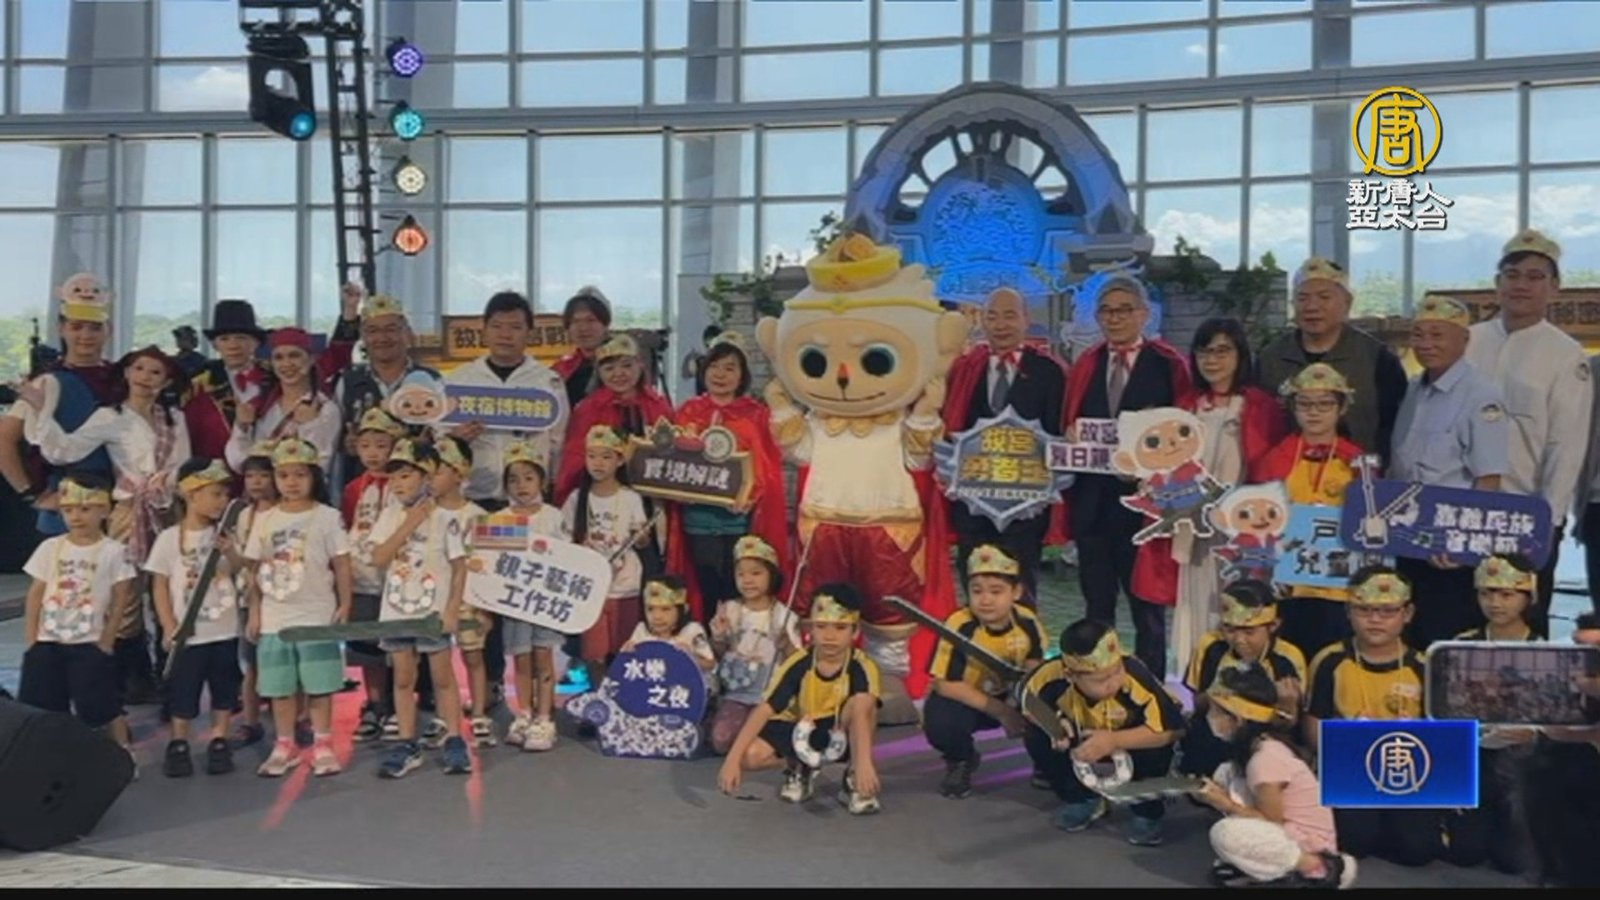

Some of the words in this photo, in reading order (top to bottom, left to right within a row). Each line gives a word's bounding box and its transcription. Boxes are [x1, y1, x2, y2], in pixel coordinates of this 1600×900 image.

[493, 552, 595, 603] 親子藝術
[498, 584, 575, 623] 工作坊
[623, 658, 667, 682] 水樂
[647, 684, 690, 709] 之夜
